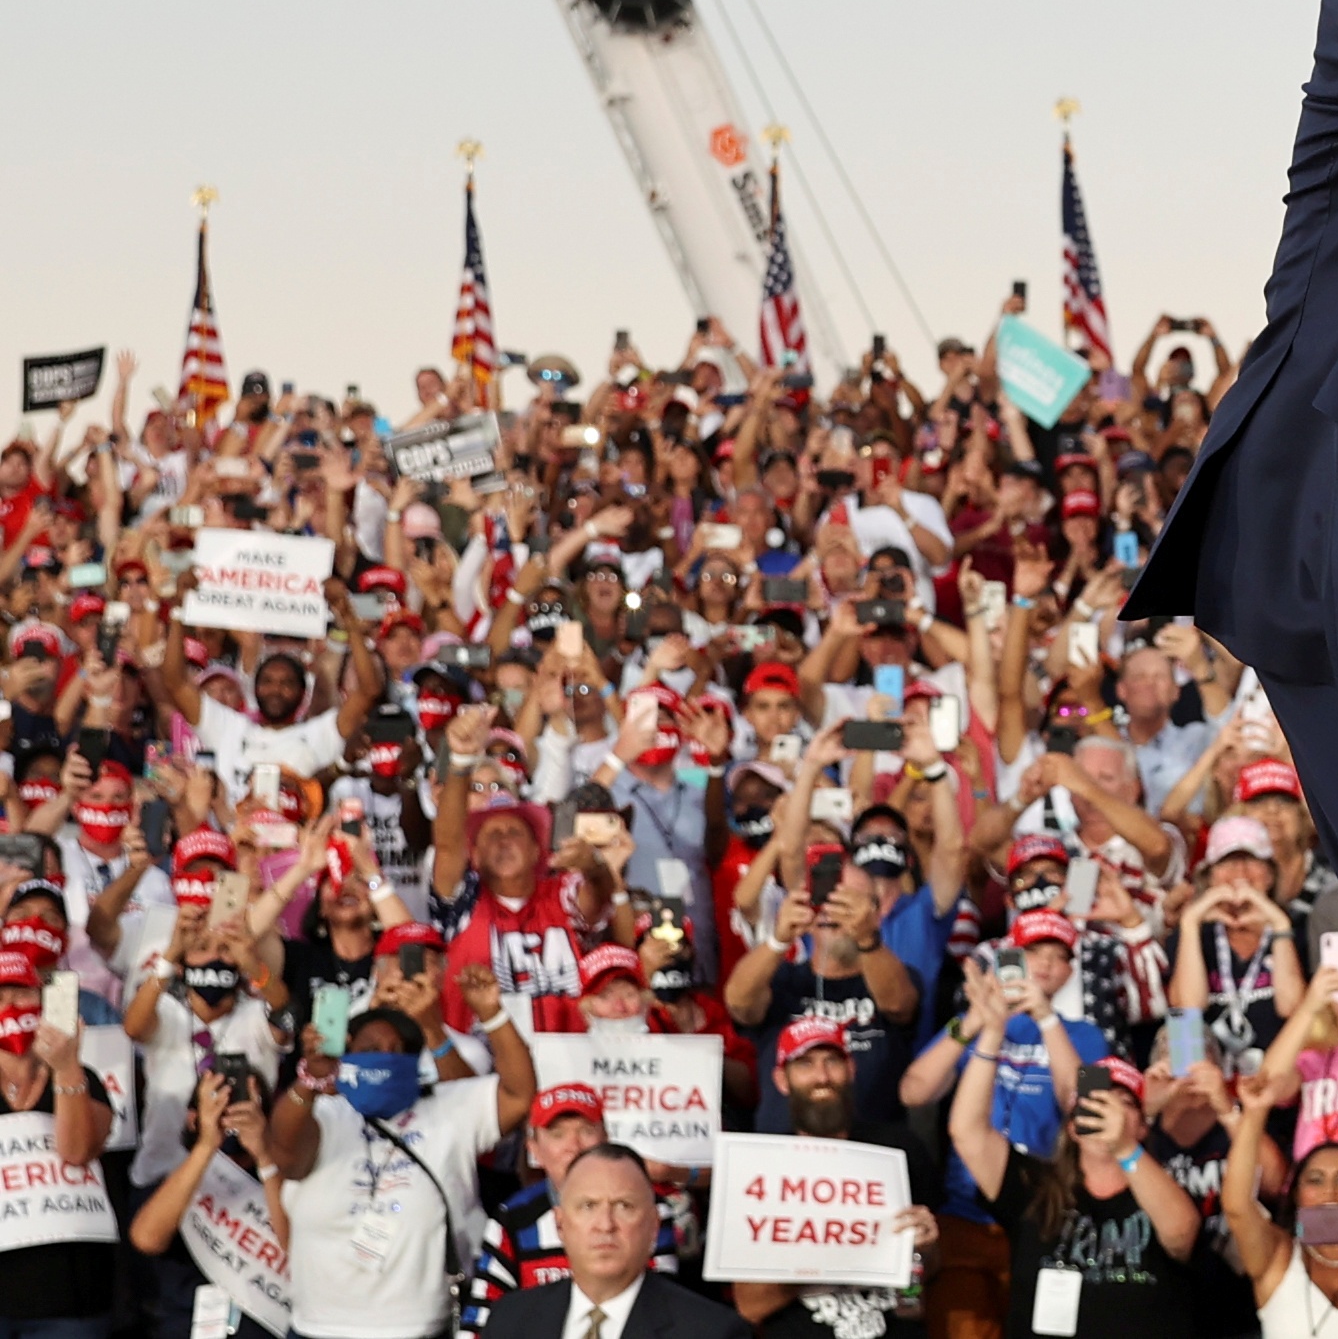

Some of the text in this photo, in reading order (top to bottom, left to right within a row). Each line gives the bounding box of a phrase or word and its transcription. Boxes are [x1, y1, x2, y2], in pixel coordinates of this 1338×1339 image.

[199, 567, 321, 594] AMERICA
[263, 596, 320, 615] AGAIN
[20, 783, 58, 800] MAG
[1014, 884, 1061, 910] MAG
[184, 967, 240, 988] MAG
[592, 1058, 662, 1076] MAKE
[602, 1083, 708, 1112] ERICA
[632, 1120, 710, 1138] AGAIN
[2, 1162, 100, 1192] ERICA
[42, 1194, 106, 1213] AGAIN
[745, 1175, 886, 1207] 4 MORE
[197, 1193, 291, 1282] AMERI
[746, 1216, 881, 1246] YEARS!
[191, 1213, 293, 1313] GREAT AGA
